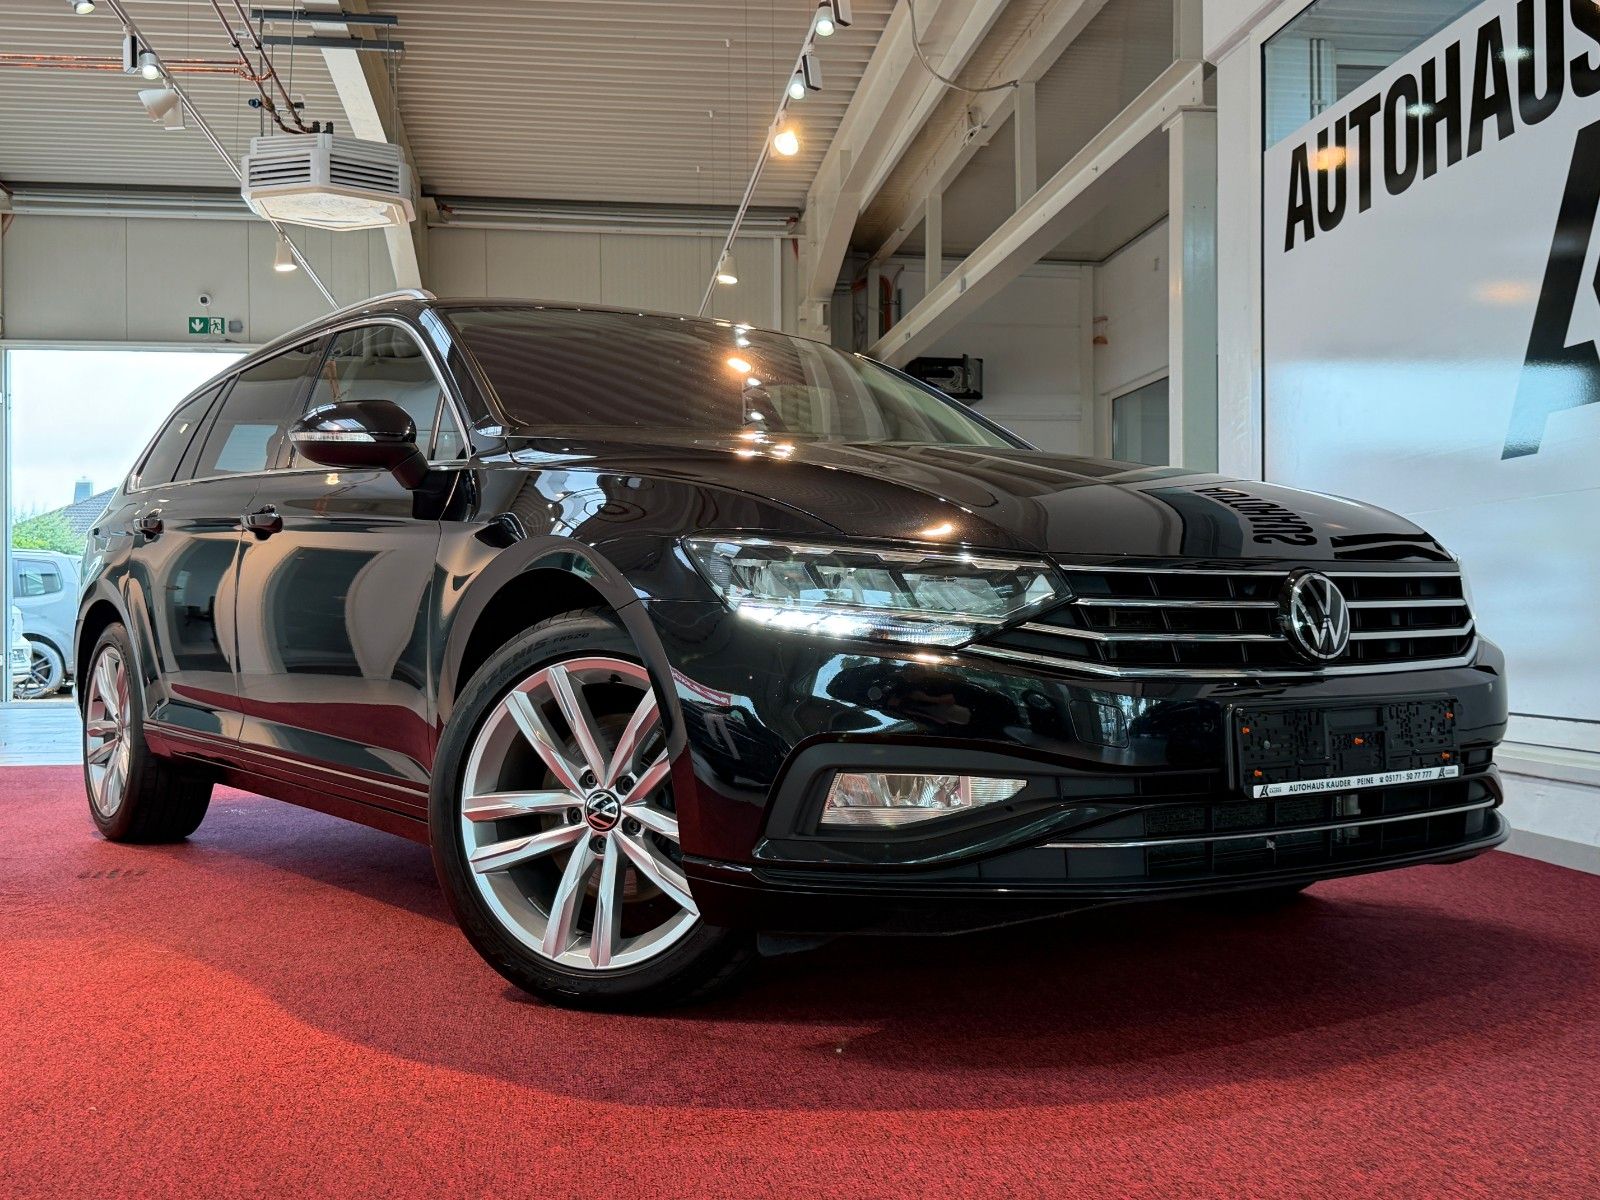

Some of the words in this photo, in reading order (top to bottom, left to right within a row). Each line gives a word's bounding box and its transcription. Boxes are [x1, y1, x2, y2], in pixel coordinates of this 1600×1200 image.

[1284, 0, 1600, 253] AUTOHAUS
[1288, 783, 1325, 792] AUTOHAUS
[1326, 779, 1352, 789] KAUDER
[1357, 776, 1374, 785] PEINE
[1385, 773, 1402, 782] 05171
[1414, 771, 1421, 779] 77
[1422, 770, 1432, 778] 777
